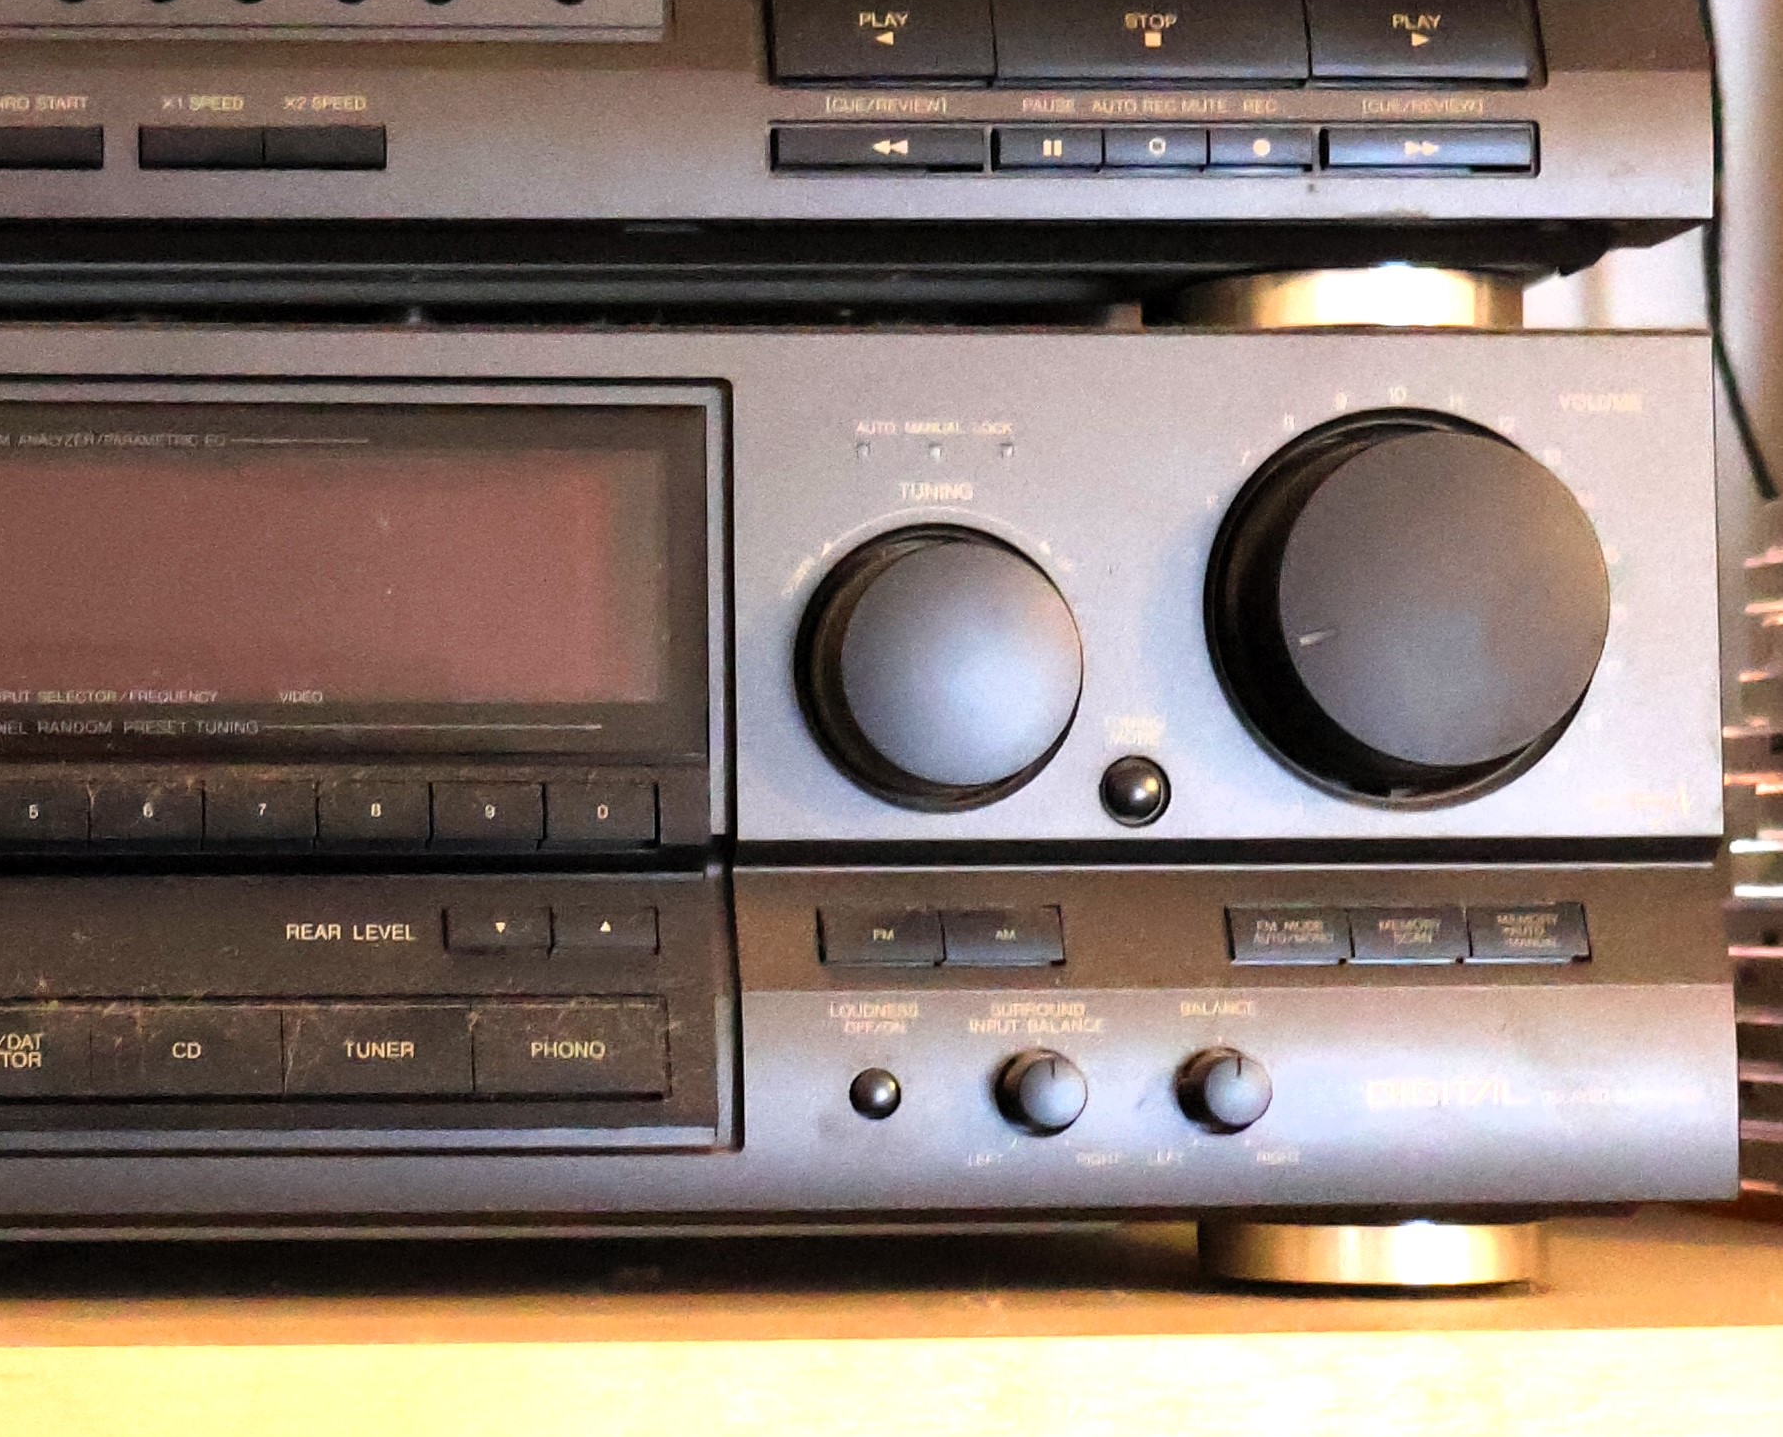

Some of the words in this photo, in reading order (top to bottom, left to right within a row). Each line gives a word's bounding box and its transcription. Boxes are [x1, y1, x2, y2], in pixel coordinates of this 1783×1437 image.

[859, 13, 908, 29] PLAY
[1125, 14, 1177, 29] STOP
[1392, 13, 1441, 30] PLAY
[35, 96, 89, 111] START
[1022, 98, 1077, 113] PAUSE
[1092, 98, 1136, 114] AUTO
[1142, 98, 1177, 114] REC
[898, 482, 974, 501] TUNING
[279, 691, 323, 703] VIDEO
[37, 721, 113, 735] RANDOM
[123, 721, 187, 735] PRESET
[196, 721, 259, 735] TUNING
[257, 803, 267, 817] 7
[286, 923, 341, 940] REAR
[353, 923, 416, 941] LEVEL
[829, 1003, 919, 1018] LOUDNESS
[989, 1002, 1086, 1018] SURROUND
[1180, 1000, 1257, 1017] BALANCE
[968, 1018, 1020, 1033] INPUT
[1026, 1019, 1103, 1034] BALANCE
[172, 1042, 202, 1059] CD
[345, 1040, 415, 1058] TUNER
[530, 1041, 607, 1058] PHONO
